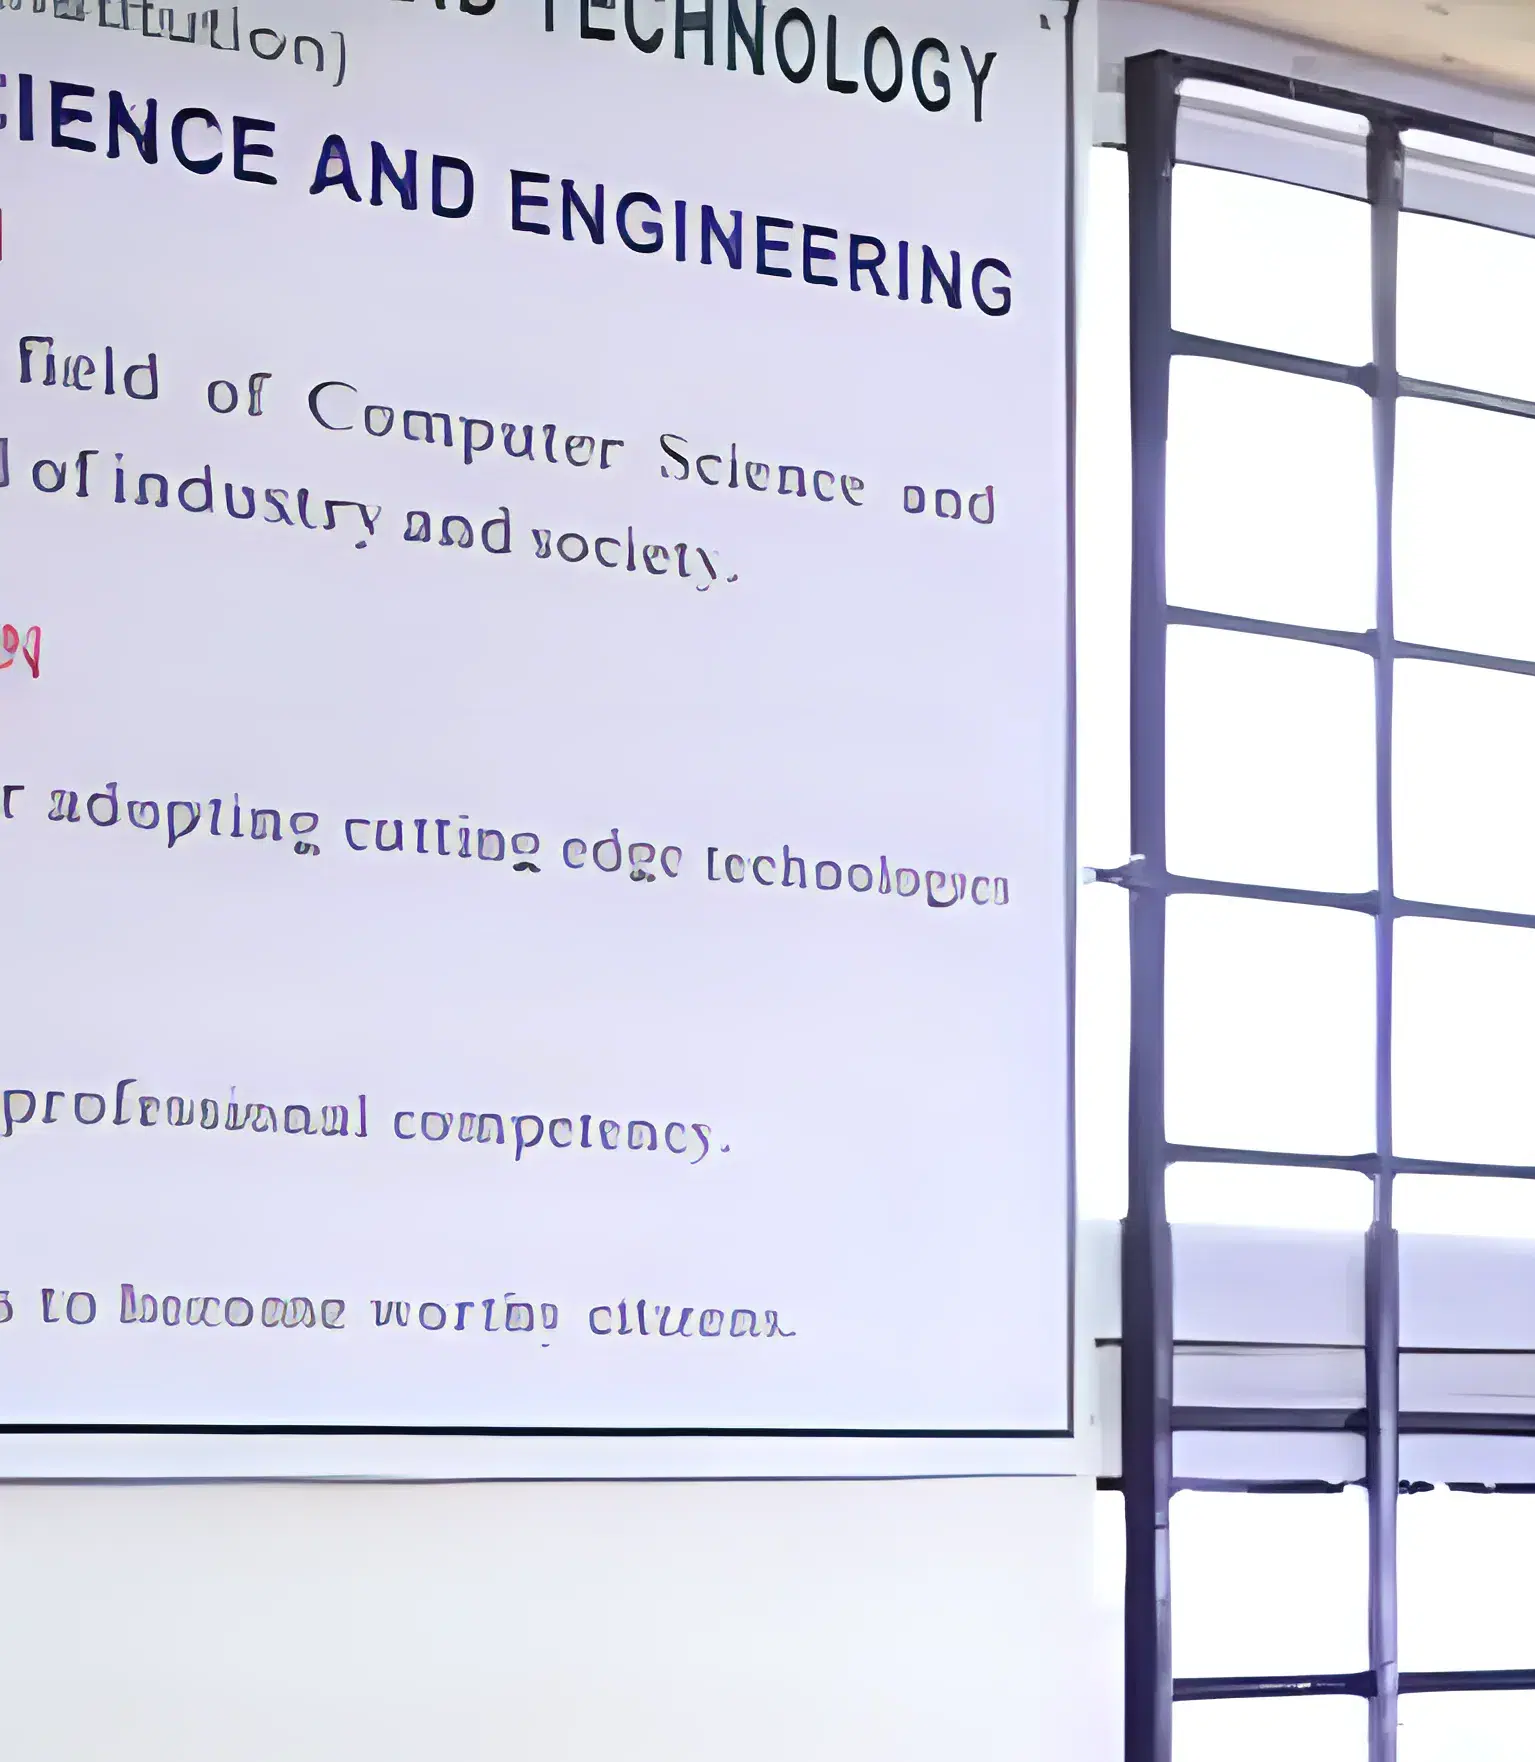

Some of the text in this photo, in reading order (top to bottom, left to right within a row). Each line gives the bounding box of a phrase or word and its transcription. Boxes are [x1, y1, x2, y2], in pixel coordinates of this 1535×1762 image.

[0, 73, 1013, 318] IENCE AND ENGINEERING
[19, 335, 159, 400] field
[207, 372, 272, 416] of
[308, 381, 625, 470] Computer
[659, 433, 865, 506] Science
[32, 449, 99, 498] of
[114, 452, 382, 549] industry
[403, 506, 513, 554] and
[48, 781, 321, 856] adopting
